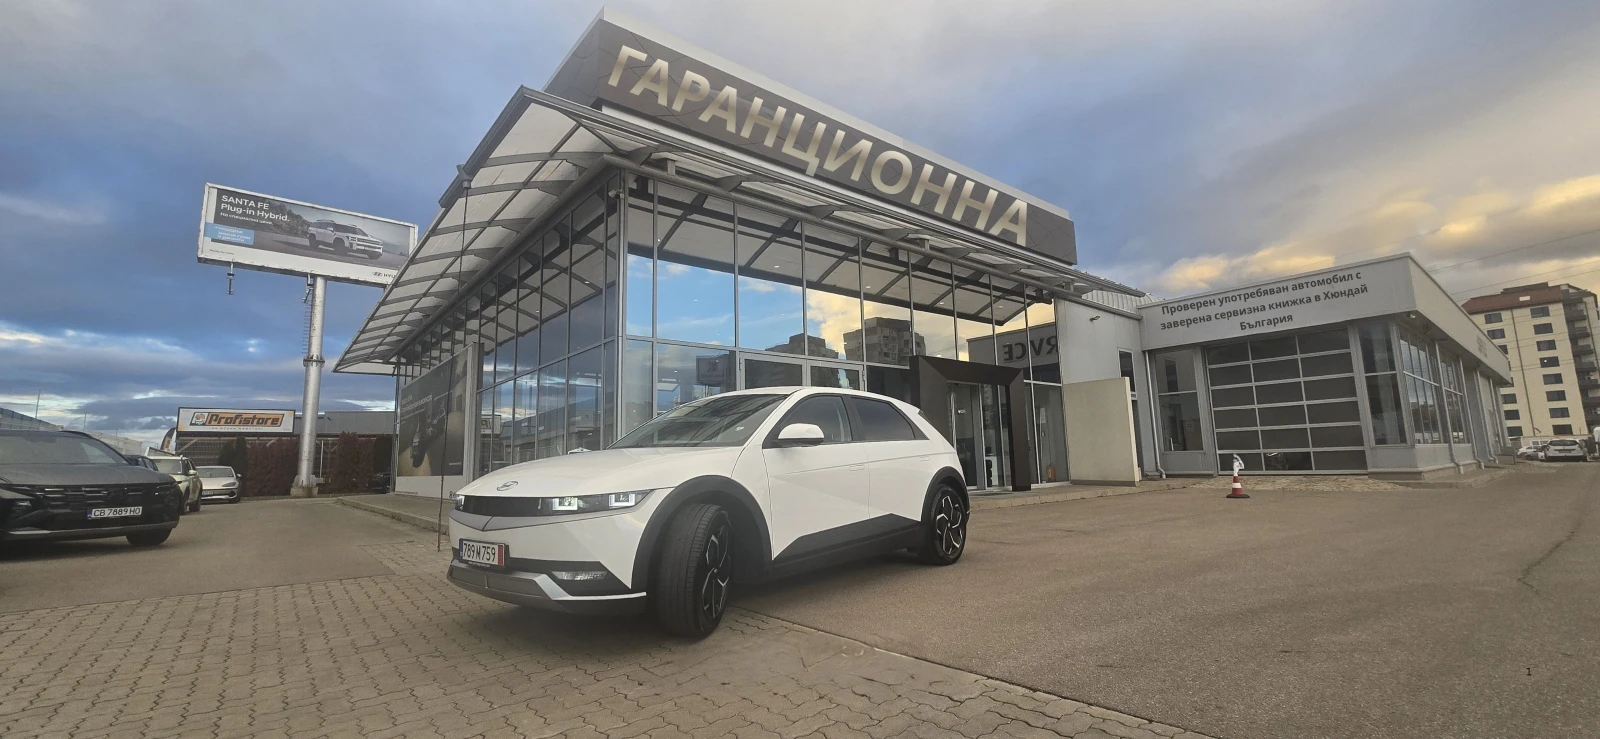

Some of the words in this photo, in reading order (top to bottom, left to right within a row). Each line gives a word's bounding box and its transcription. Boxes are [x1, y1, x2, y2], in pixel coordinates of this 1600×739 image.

[608, 45, 1028, 247] ГАРАНЦИОННА
[221, 195, 256, 208] SANTA
[257, 202, 270, 210] FE
[220, 203, 255, 216] Plug-in
[257, 209, 290, 222] Hybrid.
[1161, 298, 1216, 316] Проверен
[1218, 285, 1289, 307] употребяван
[1291, 274, 1354, 292] автомобил
[1355, 271, 1362, 280] с
[1160, 313, 1213, 331] заверена
[1214, 303, 1266, 321] сервизна
[1268, 296, 1312, 311] книжка
[1314, 294, 1321, 303] в
[1323, 284, 1368, 300] Хюндай
[1239, 314, 1293, 331] България
[208, 413, 280, 426] Profistore
